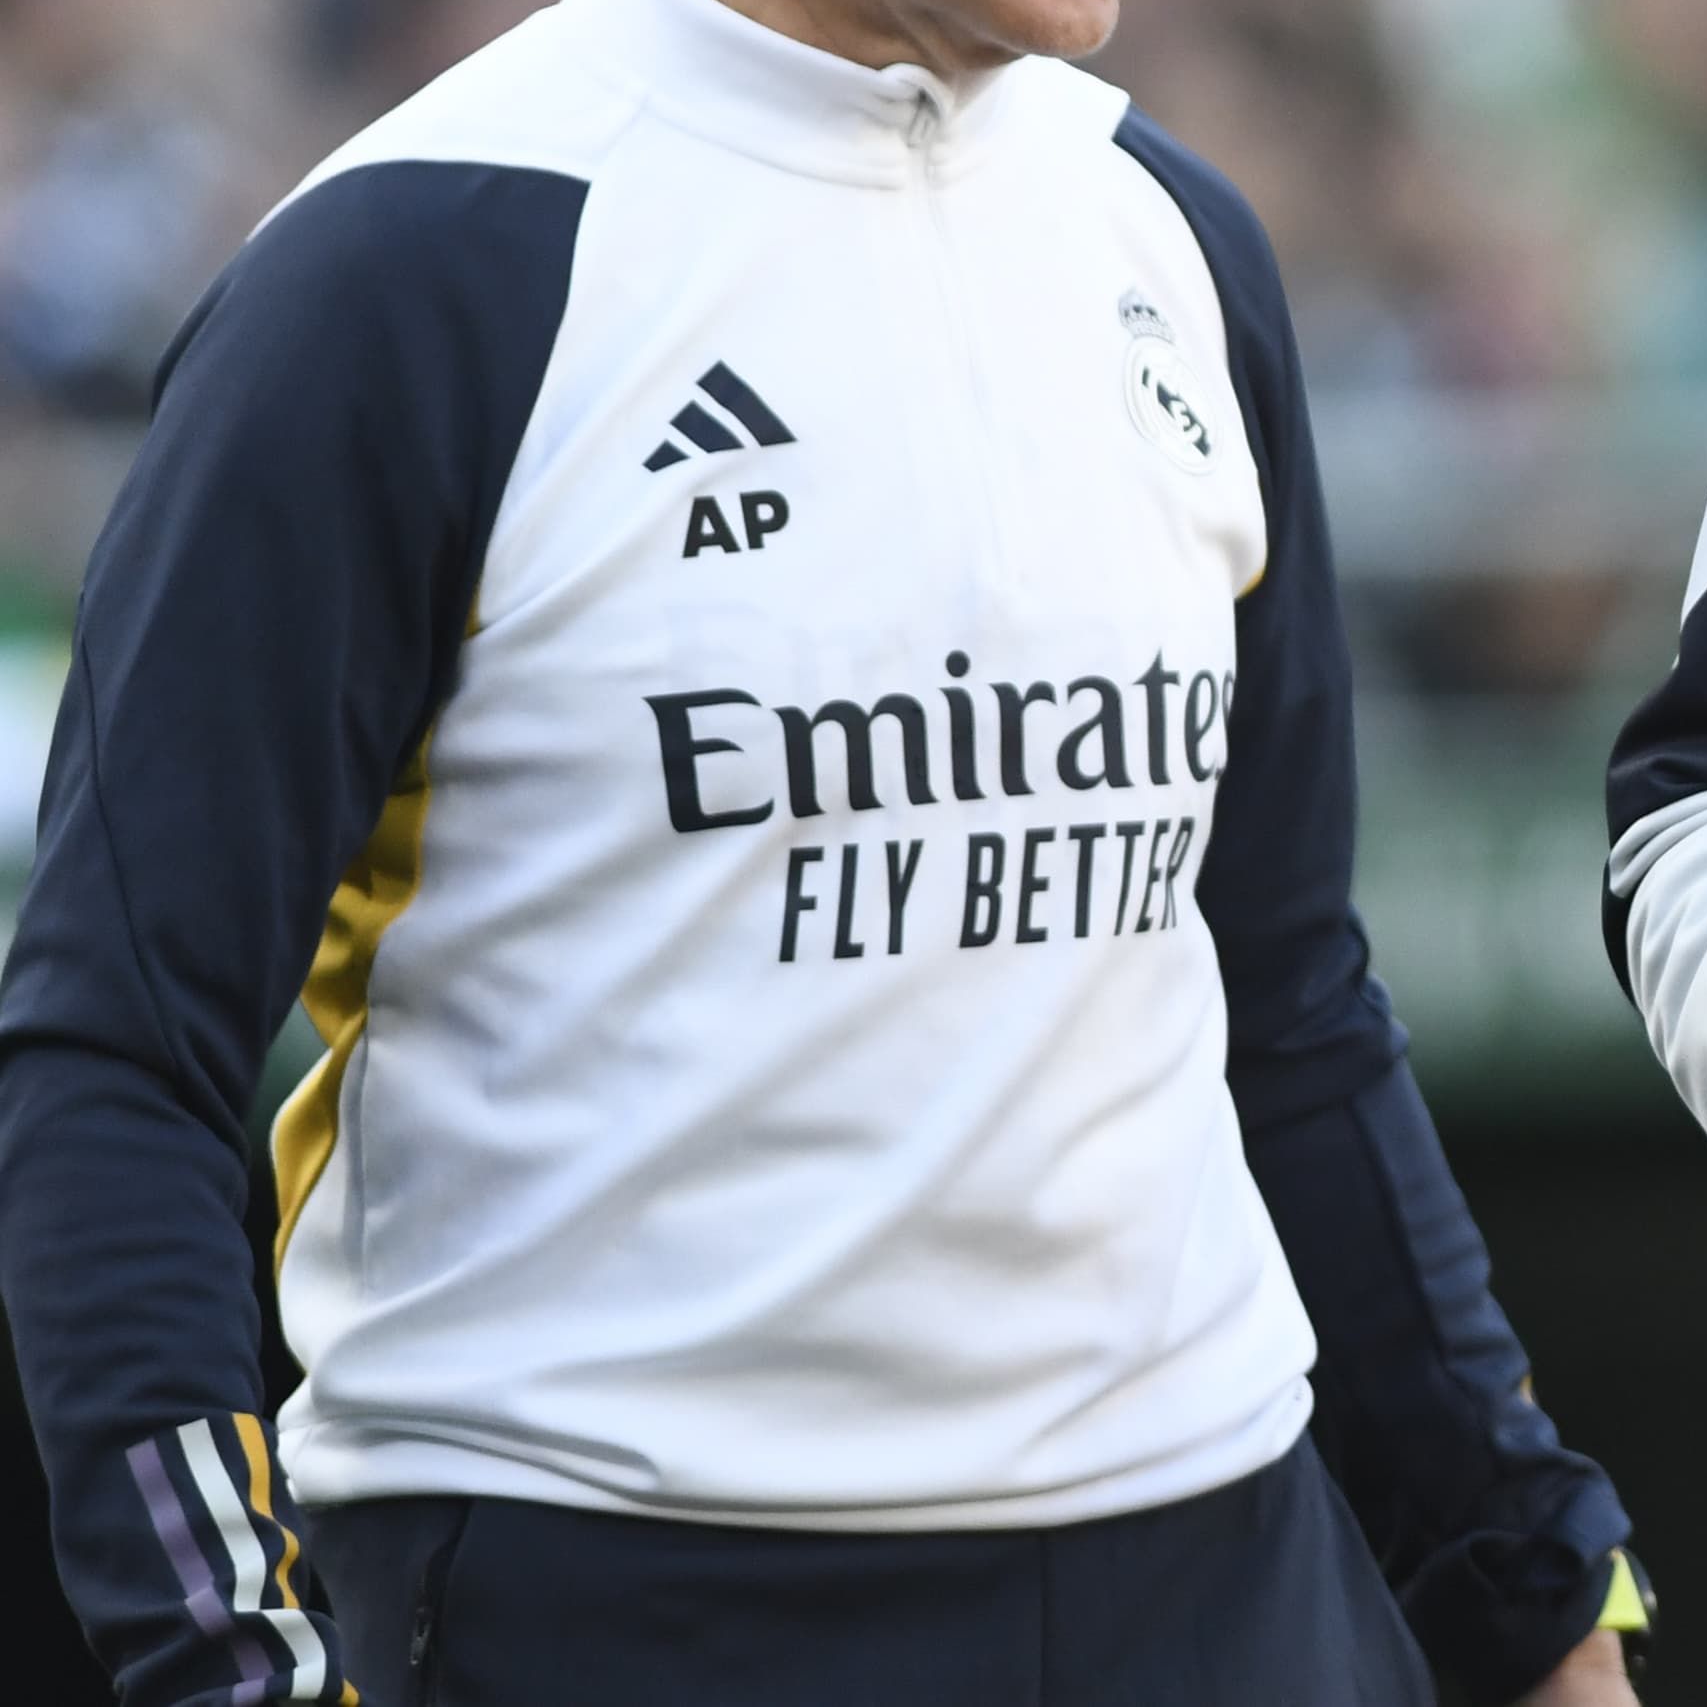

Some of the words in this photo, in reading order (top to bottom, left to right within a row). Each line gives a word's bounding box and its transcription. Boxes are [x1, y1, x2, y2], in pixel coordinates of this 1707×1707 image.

[681, 489, 790, 559] AP
[778, 838, 924, 963] FLY
[957, 816, 1195, 950] BETTER
